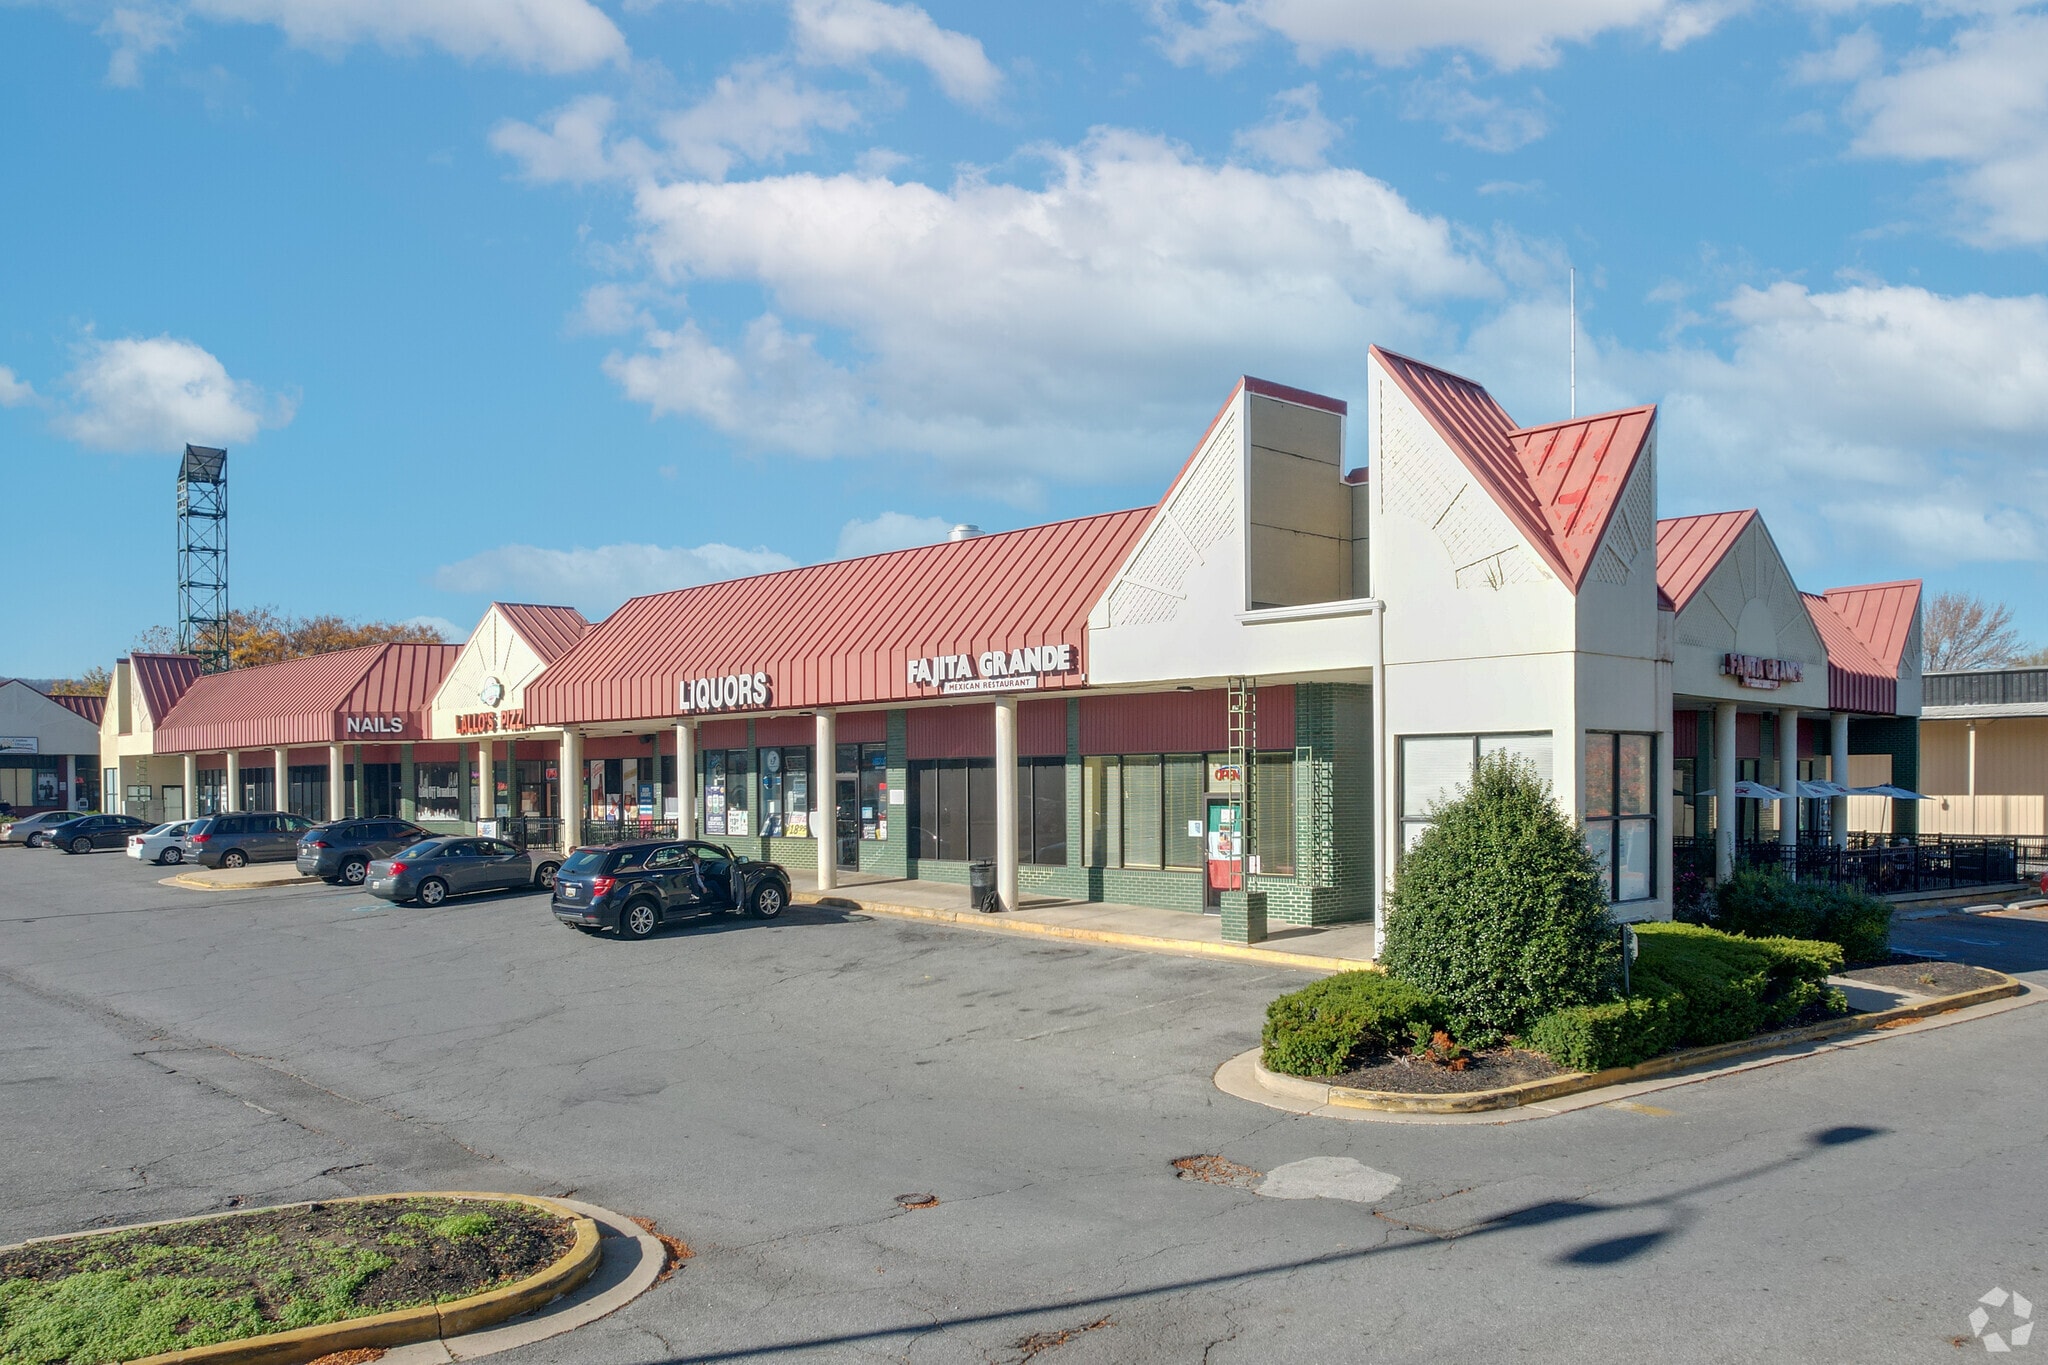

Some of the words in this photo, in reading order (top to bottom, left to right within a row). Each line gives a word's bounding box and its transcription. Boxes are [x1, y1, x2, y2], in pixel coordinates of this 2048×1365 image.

[908, 654, 972, 687] FAJITA
[979, 644, 1070, 677] GRANDE
[680, 671, 767, 710] LIQUORS
[949, 682, 980, 691] MEXICAN
[983, 679, 1030, 689] RESTAURANT
[347, 717, 403, 733] NAILS
[455, 711, 495, 735] LALLO'S
[501, 708, 526, 731] PIZZ
[1215, 769, 1241, 781] OPEN
